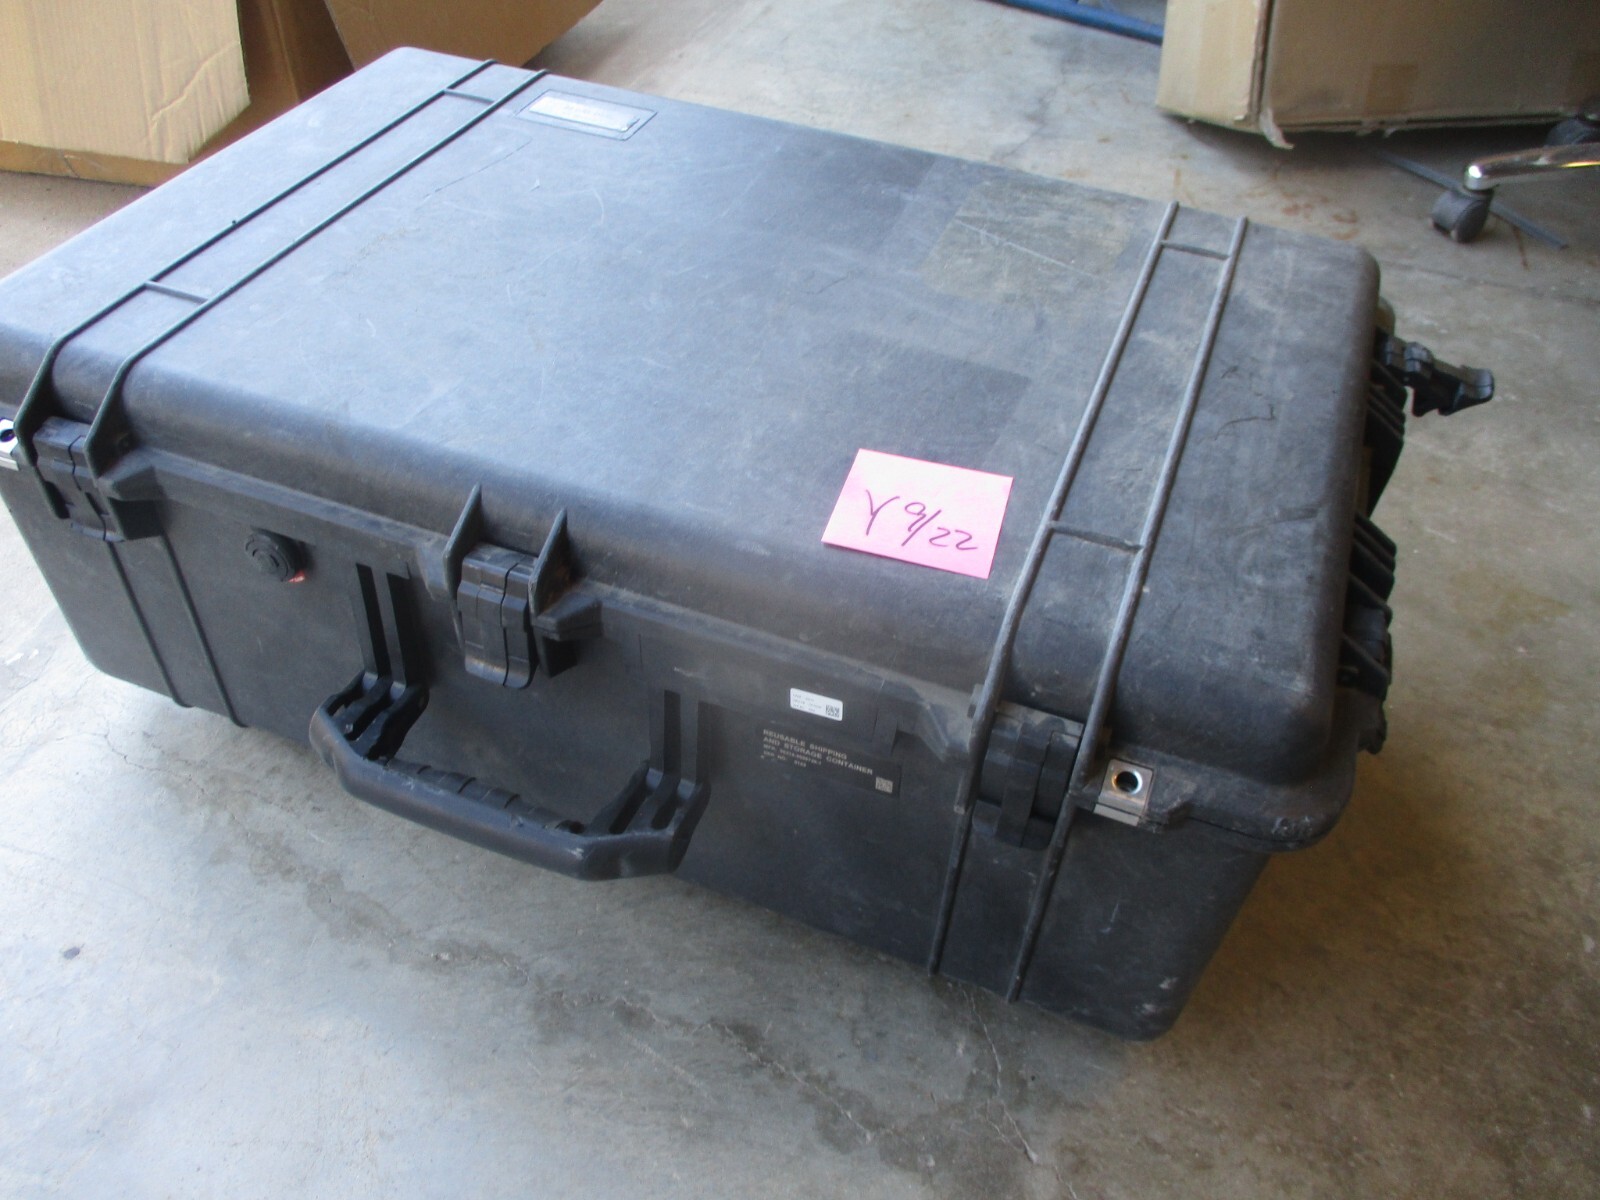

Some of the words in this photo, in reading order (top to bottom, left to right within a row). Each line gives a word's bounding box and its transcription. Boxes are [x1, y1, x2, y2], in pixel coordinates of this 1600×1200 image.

[763, 729, 806, 747] REUSABLE
[809, 743, 847, 760] SHIPPING
[763, 737, 780, 747] AND
[783, 743, 822, 760] STORAGE
[826, 756, 873, 775] CONTAINER
